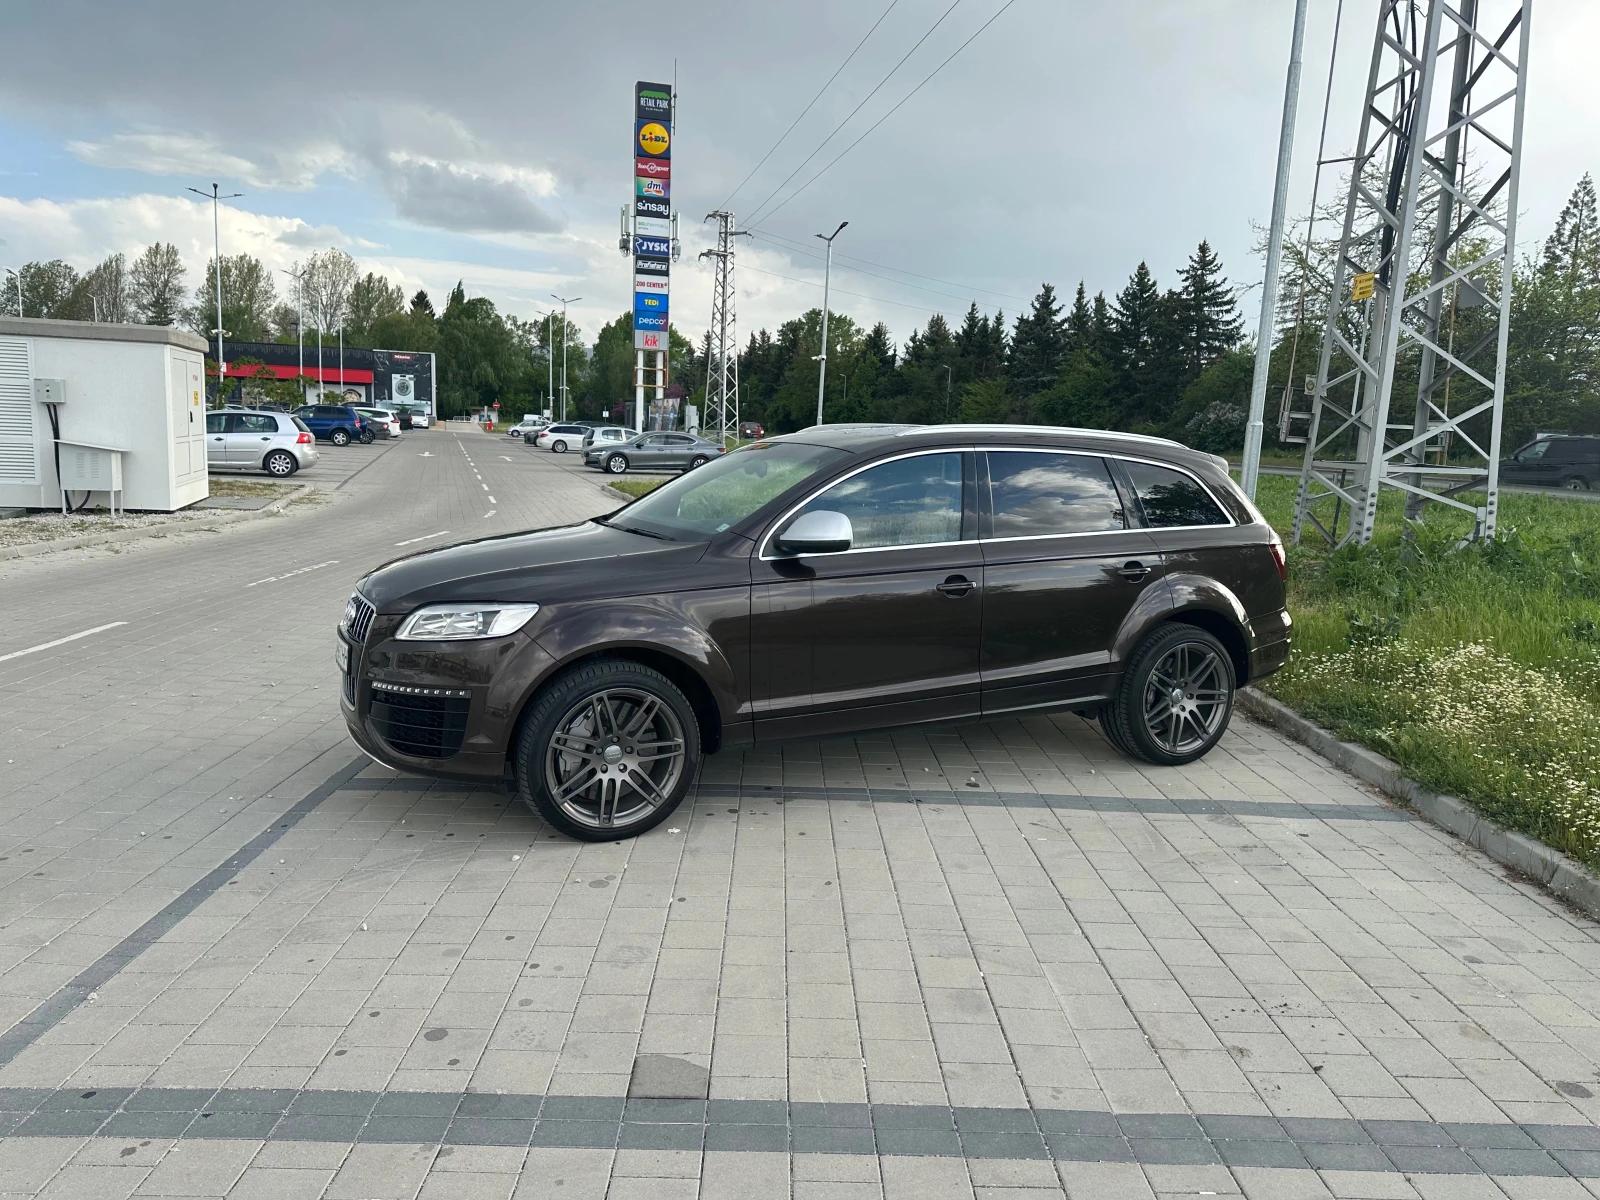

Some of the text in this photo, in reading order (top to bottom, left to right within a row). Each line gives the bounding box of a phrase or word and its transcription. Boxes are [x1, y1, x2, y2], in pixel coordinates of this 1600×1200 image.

[656, 99, 668, 109] PARK
[647, 181, 661, 190] dm
[637, 200, 669, 215] sinsay
[641, 241, 668, 252] JYSK
[638, 316, 664, 326] pepco
